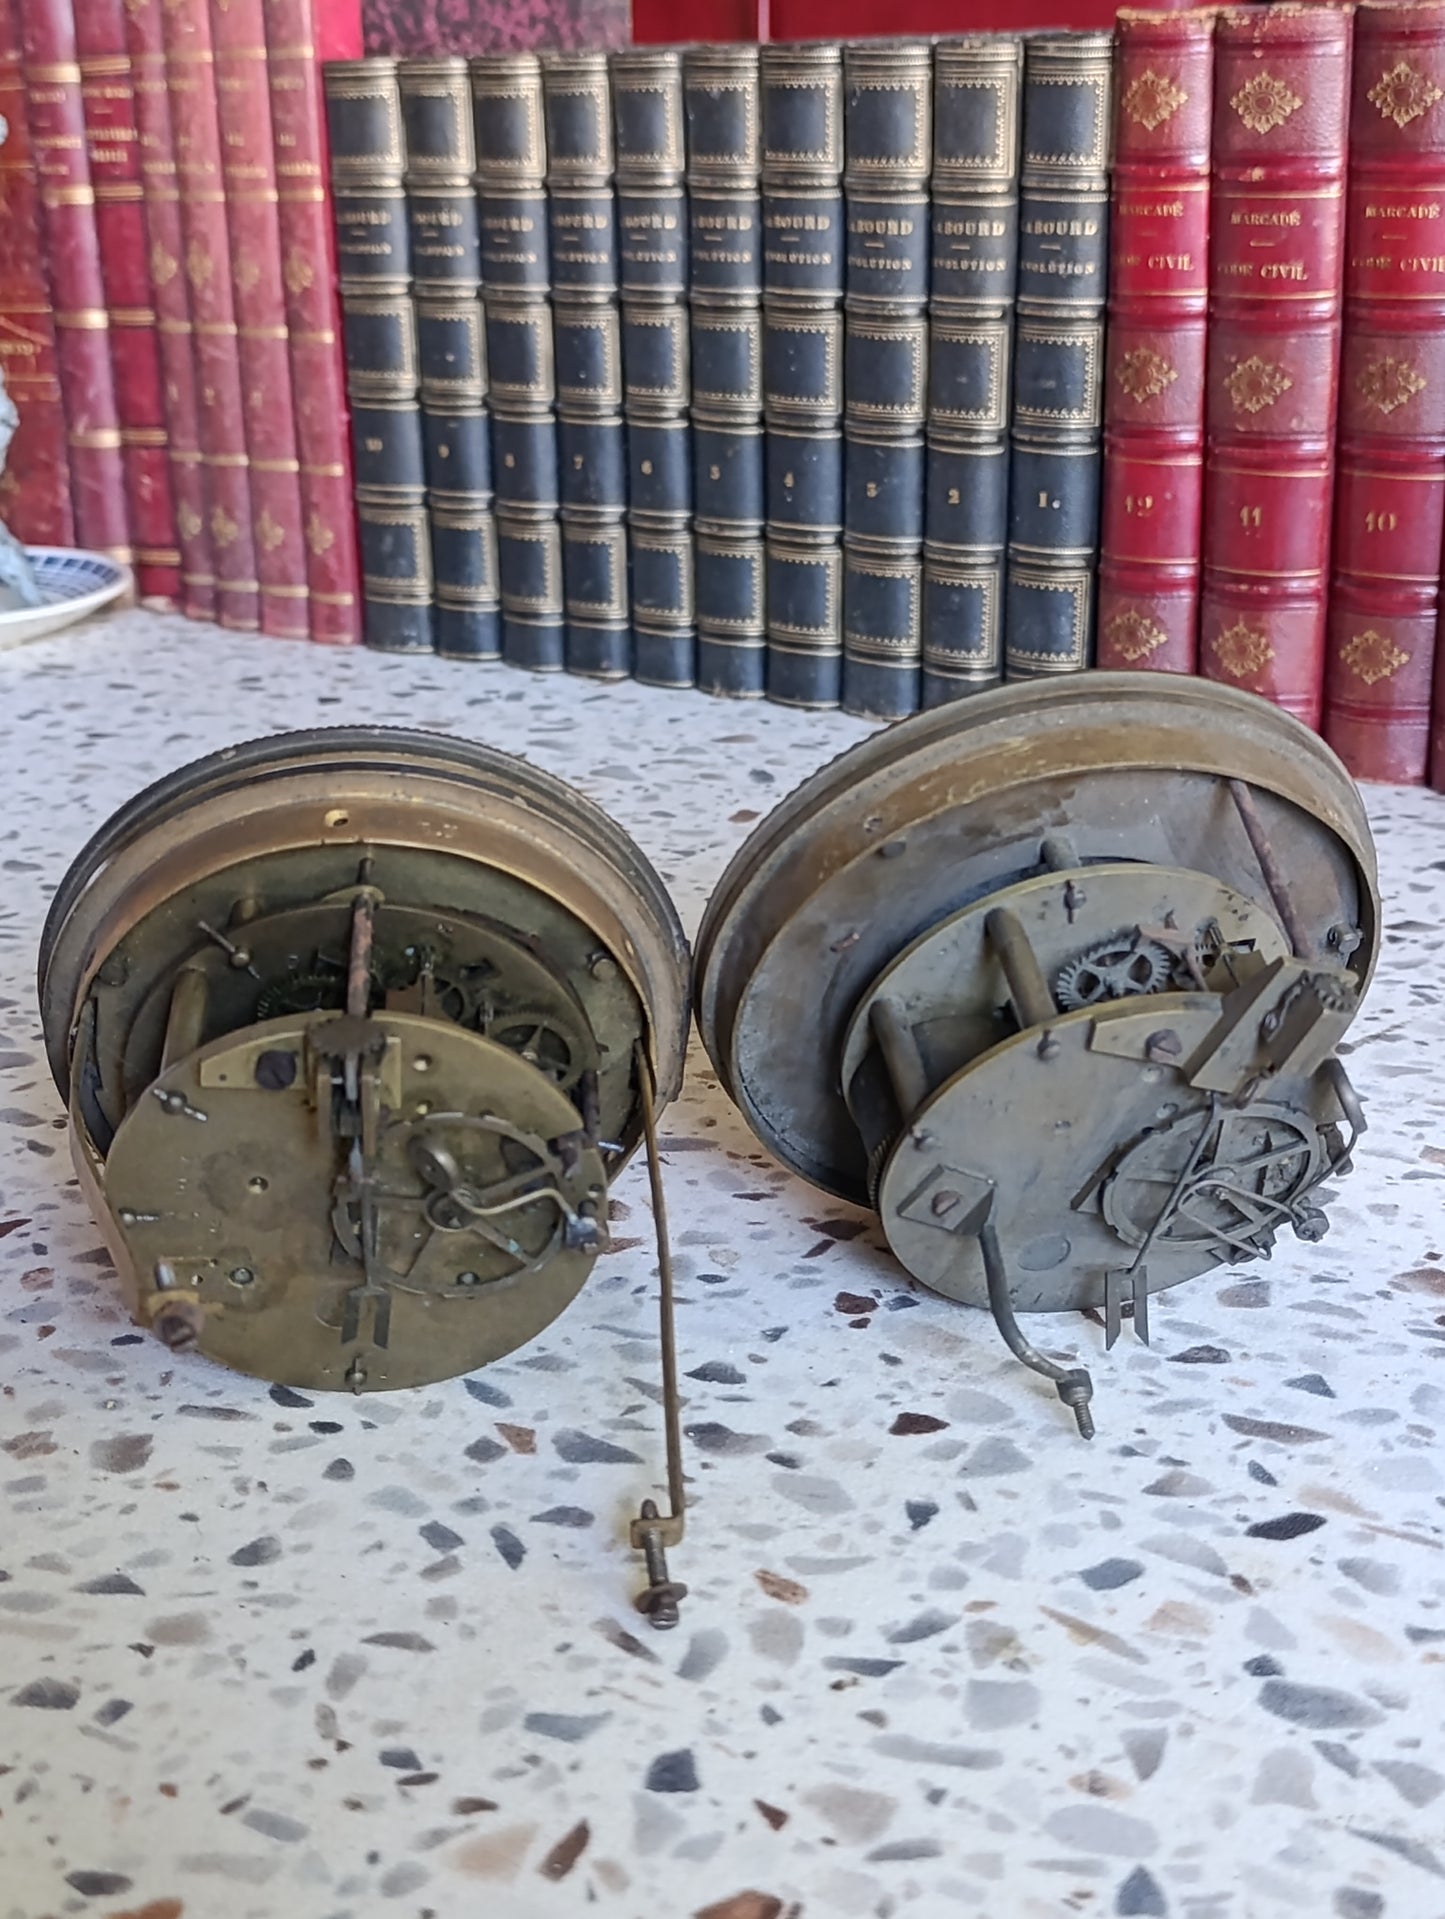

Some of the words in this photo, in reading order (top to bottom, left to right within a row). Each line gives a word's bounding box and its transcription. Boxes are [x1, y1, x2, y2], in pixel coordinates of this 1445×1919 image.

[1148, 253, 1195, 271] CIVIL
[1260, 259, 1309, 281] CIVIL
[948, 488, 960, 504] 2
[1239, 505, 1262, 528] 11
[1365, 511, 1397, 533] 10
